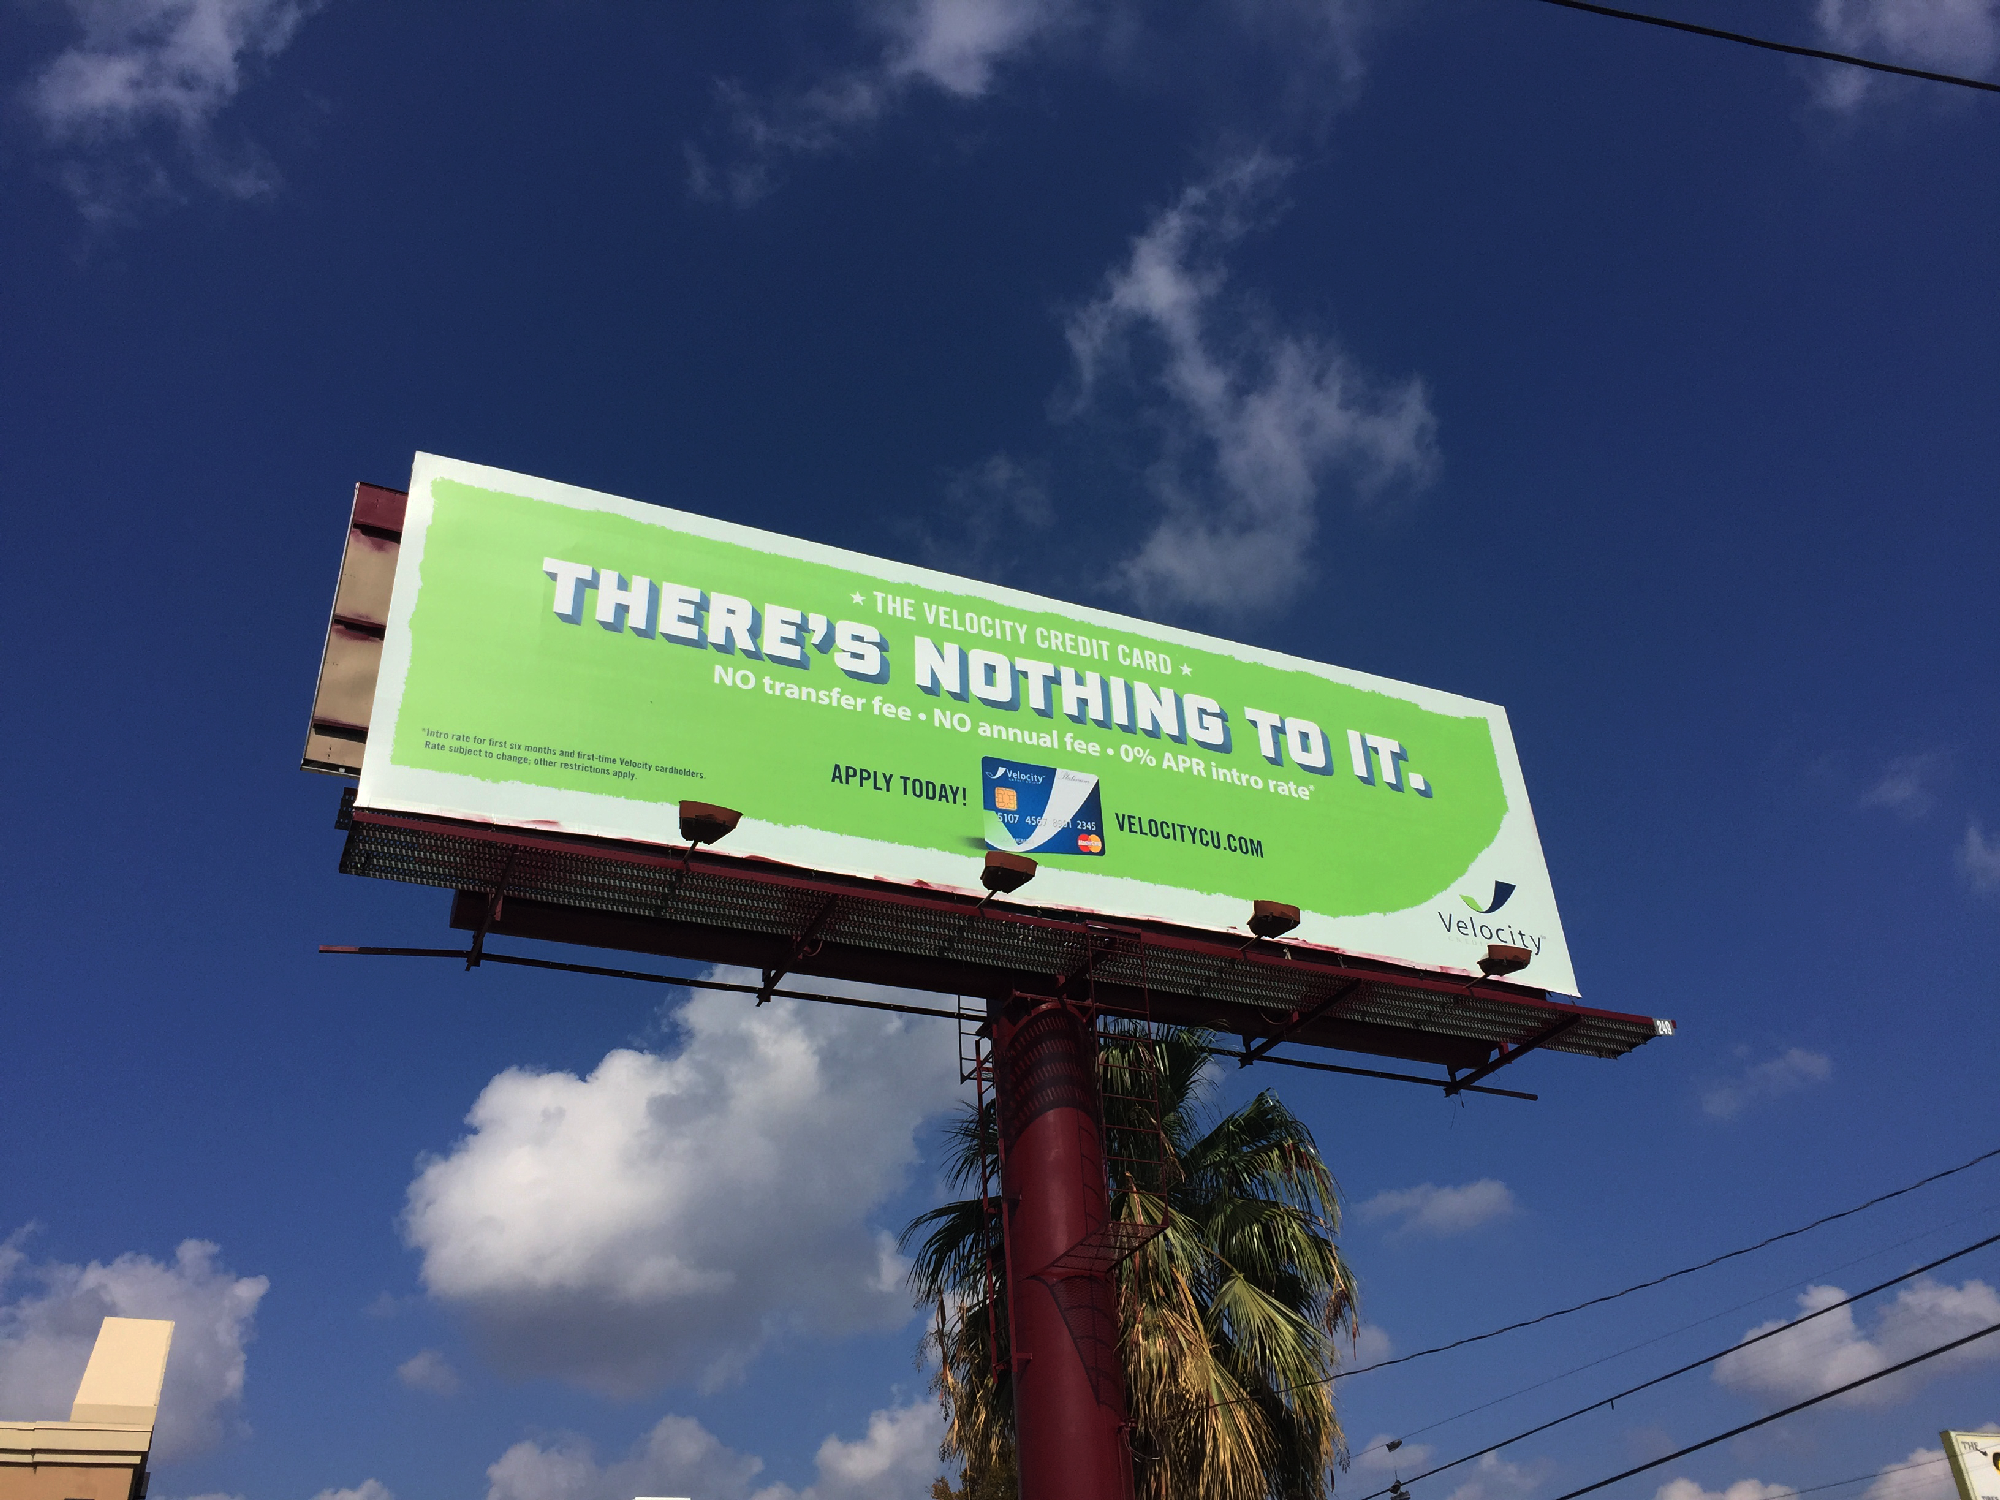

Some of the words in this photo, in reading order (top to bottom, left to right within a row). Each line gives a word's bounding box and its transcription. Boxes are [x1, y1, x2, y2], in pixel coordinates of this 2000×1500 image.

[873, 591, 917, 621] THE
[923, 602, 1028, 645] VELOCITY
[1035, 627, 1111, 662] CREDIT
[1117, 644, 1172, 676] CARD
[543, 557, 890, 685] THERE'S
[915, 636, 1231, 753] NOTHING
[1244, 707, 1333, 776] TO
[1347, 729, 1432, 799] IT.
[713, 665, 756, 690] NO
[763, 676, 867, 712] transfer
[872, 696, 912, 721] fee
[934, 708, 972, 732] NO
[978, 721, 1058, 749] annual
[1064, 732, 1101, 757] fee
[1120, 744, 1157, 767] 0%
[1162, 752, 1206, 778] APR
[1211, 762, 1264, 790] intro
[424, 740, 446, 751] Rate
[448, 744, 483, 757] subject
[484, 750, 494, 759] to
[533, 758, 558, 768] other
[560, 761, 611, 776] restrictions
[612, 769, 638, 781] apply.
[451, 733, 471, 743] rate
[473, 735, 487, 745] for
[488, 737, 508, 749] first
[509, 742, 522, 751] six
[524, 745, 557, 756] months
[559, 749, 575, 759] and
[577, 751, 617, 765] first-time
[619, 757, 653, 772] Velocity
[655, 765, 706, 780] cardholders.
[1006, 768, 1043, 785] Velocity
[831, 763, 894, 793] APPLY
[900, 775, 967, 807] TODAY!
[1076, 820, 1096, 831] 2345
[1115, 812, 1264, 859] VELOCITYCU.COM
[1438, 911, 1541, 956] Velocity
[1961, 1441, 1979, 1451] THE
